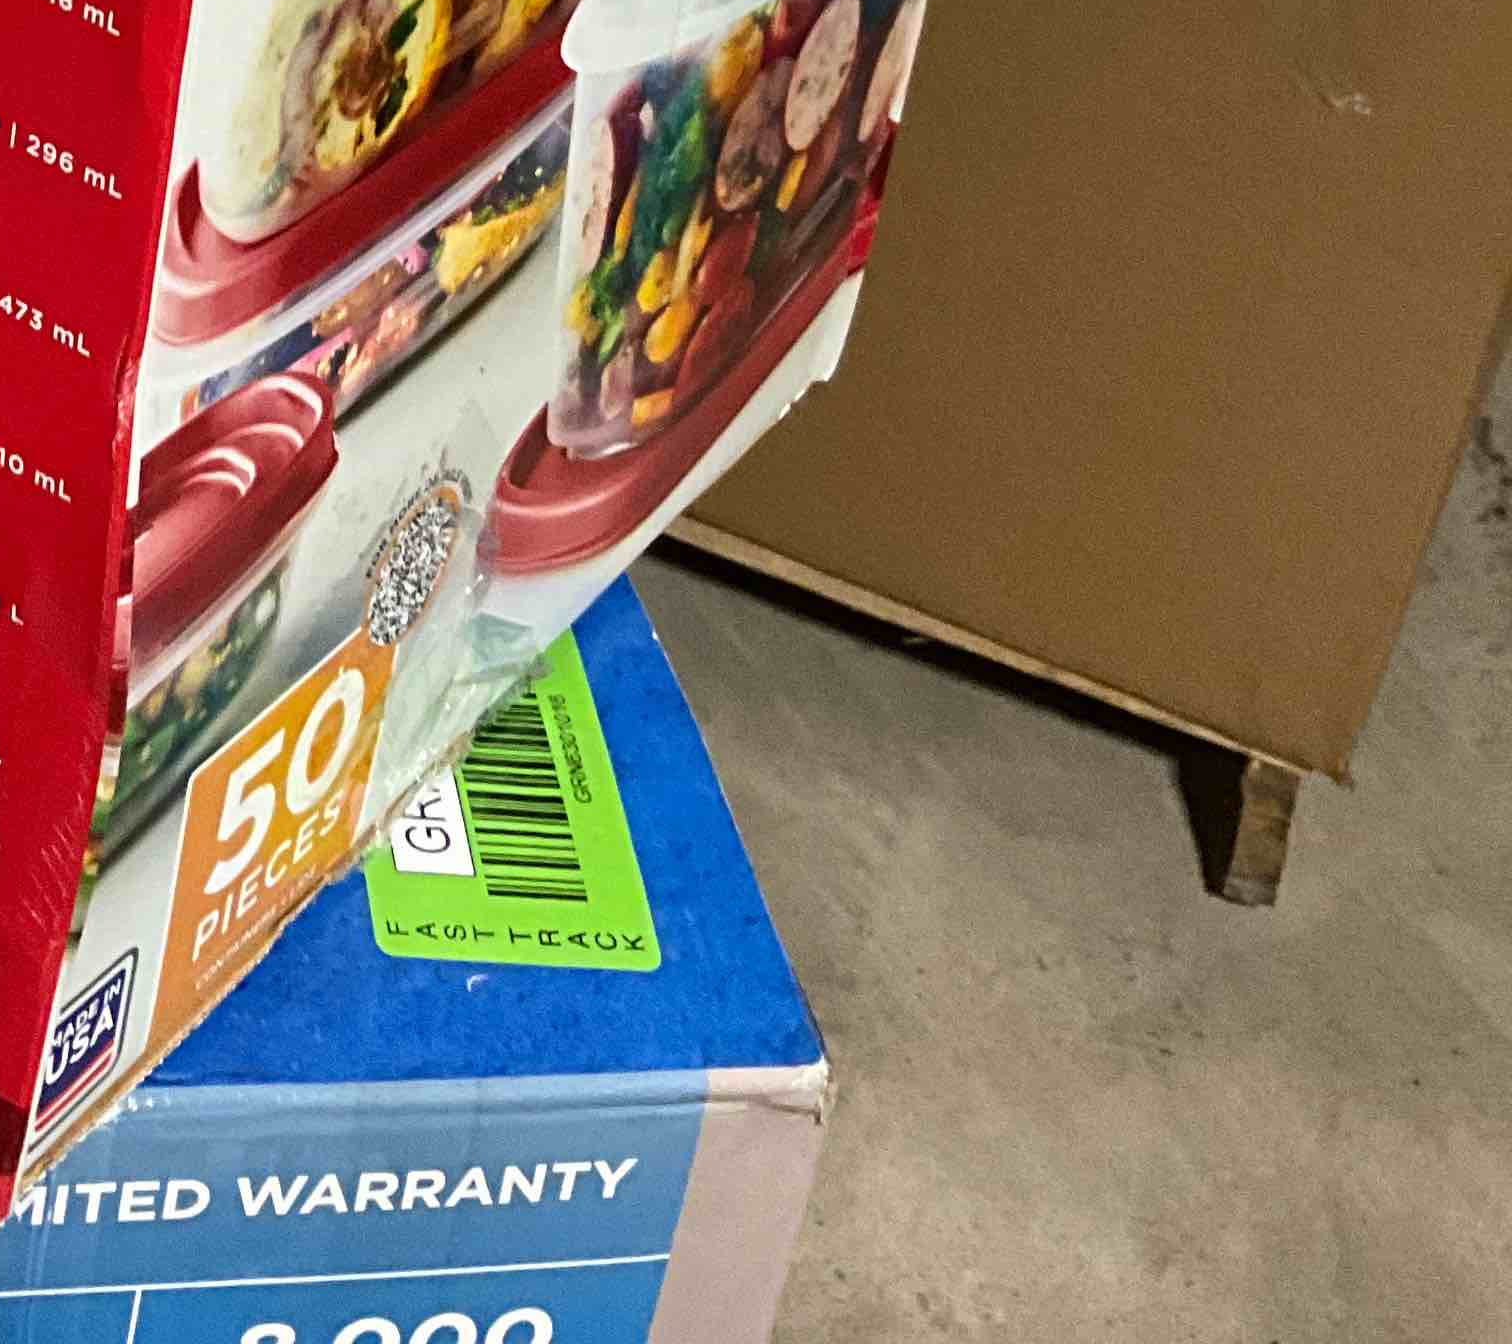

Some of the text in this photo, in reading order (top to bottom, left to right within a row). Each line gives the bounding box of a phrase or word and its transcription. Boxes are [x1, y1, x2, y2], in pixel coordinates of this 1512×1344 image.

[81, 2, 121, 38] mL
[25, 134, 75, 175] 296
[81, 165, 123, 200] mL
[51, 323, 91, 359] mL
[32, 467, 72, 504] mL
[9, 603, 25, 627] L
[203, 666, 365, 896] 50
[191, 796, 343, 962] PIECES
[386, 919, 646, 953] FAST TRACK
[52, 977, 122, 1048] MADE IN
[45, 1002, 115, 1087] USA
[237, 1157, 637, 1218] WARRANTY
